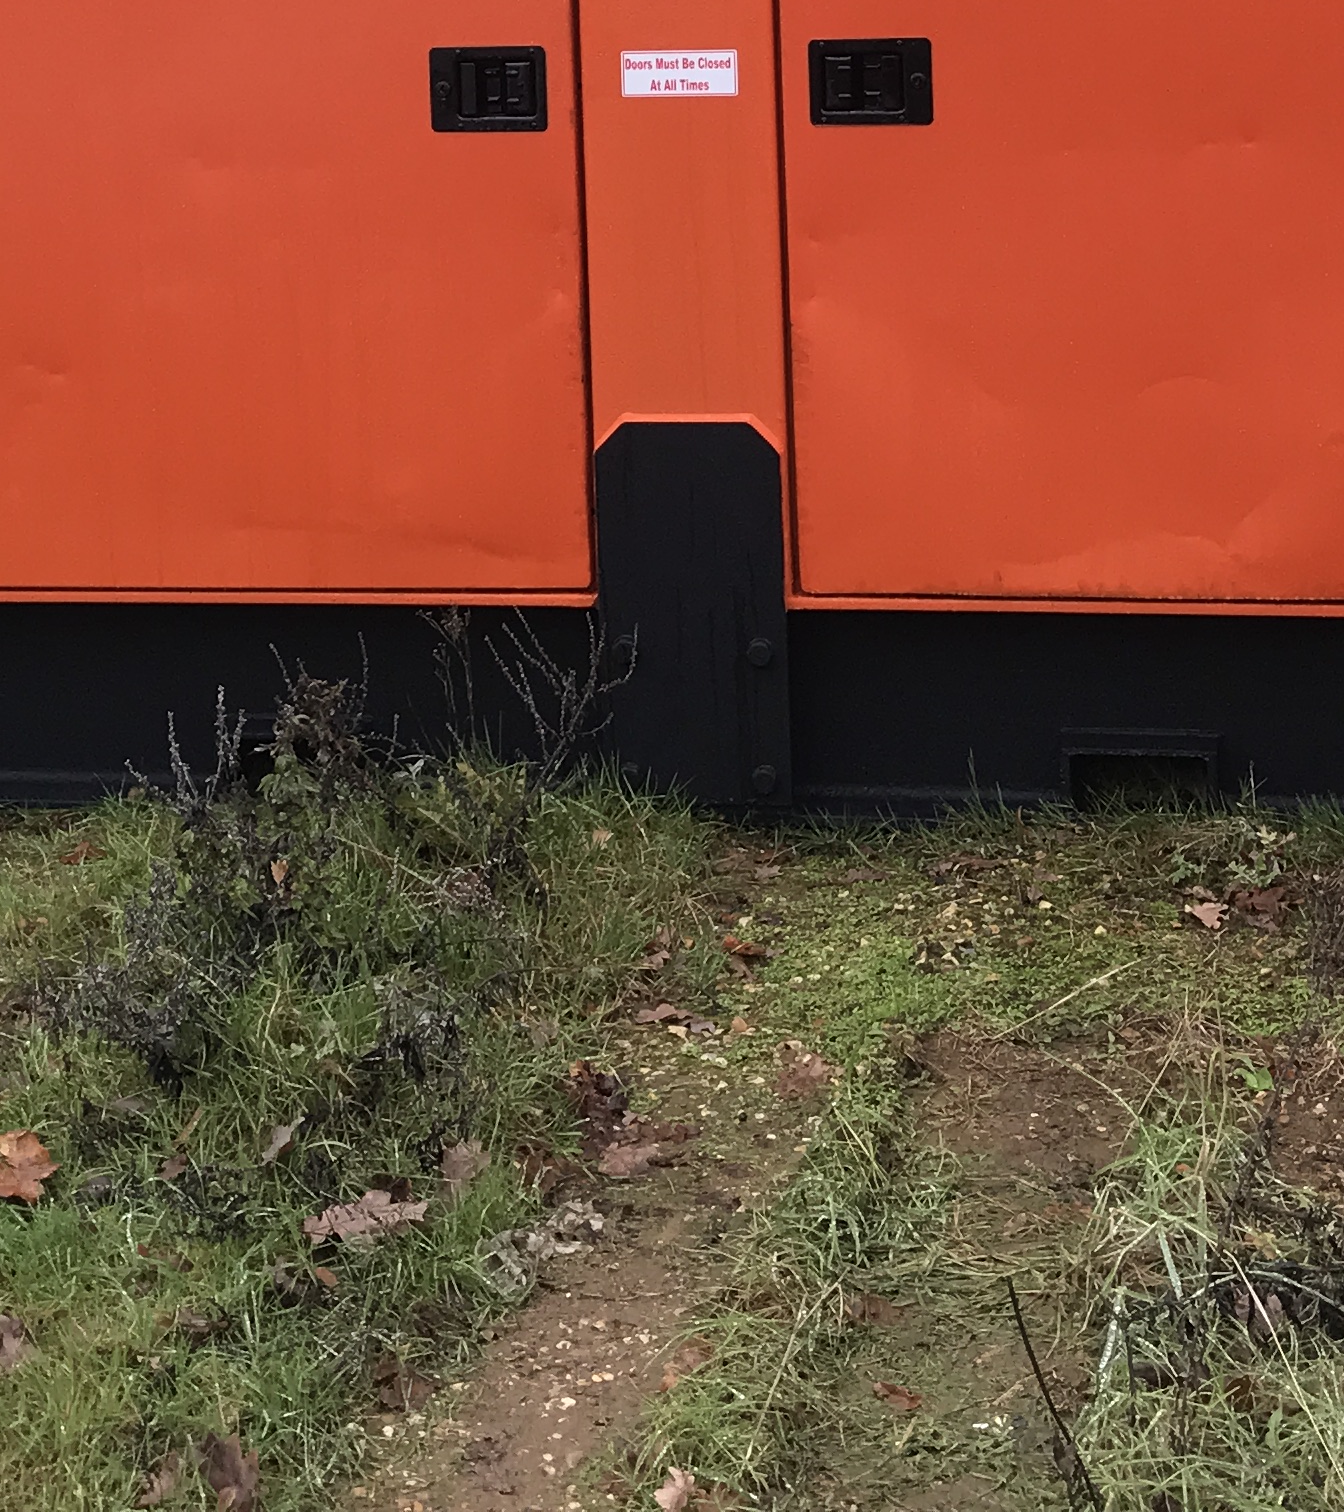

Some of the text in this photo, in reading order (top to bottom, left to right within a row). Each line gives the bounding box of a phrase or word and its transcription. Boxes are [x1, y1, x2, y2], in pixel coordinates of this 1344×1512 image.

[624, 56, 731, 71] Doors Must Be Closed
[650, 78, 710, 91] At All Times
